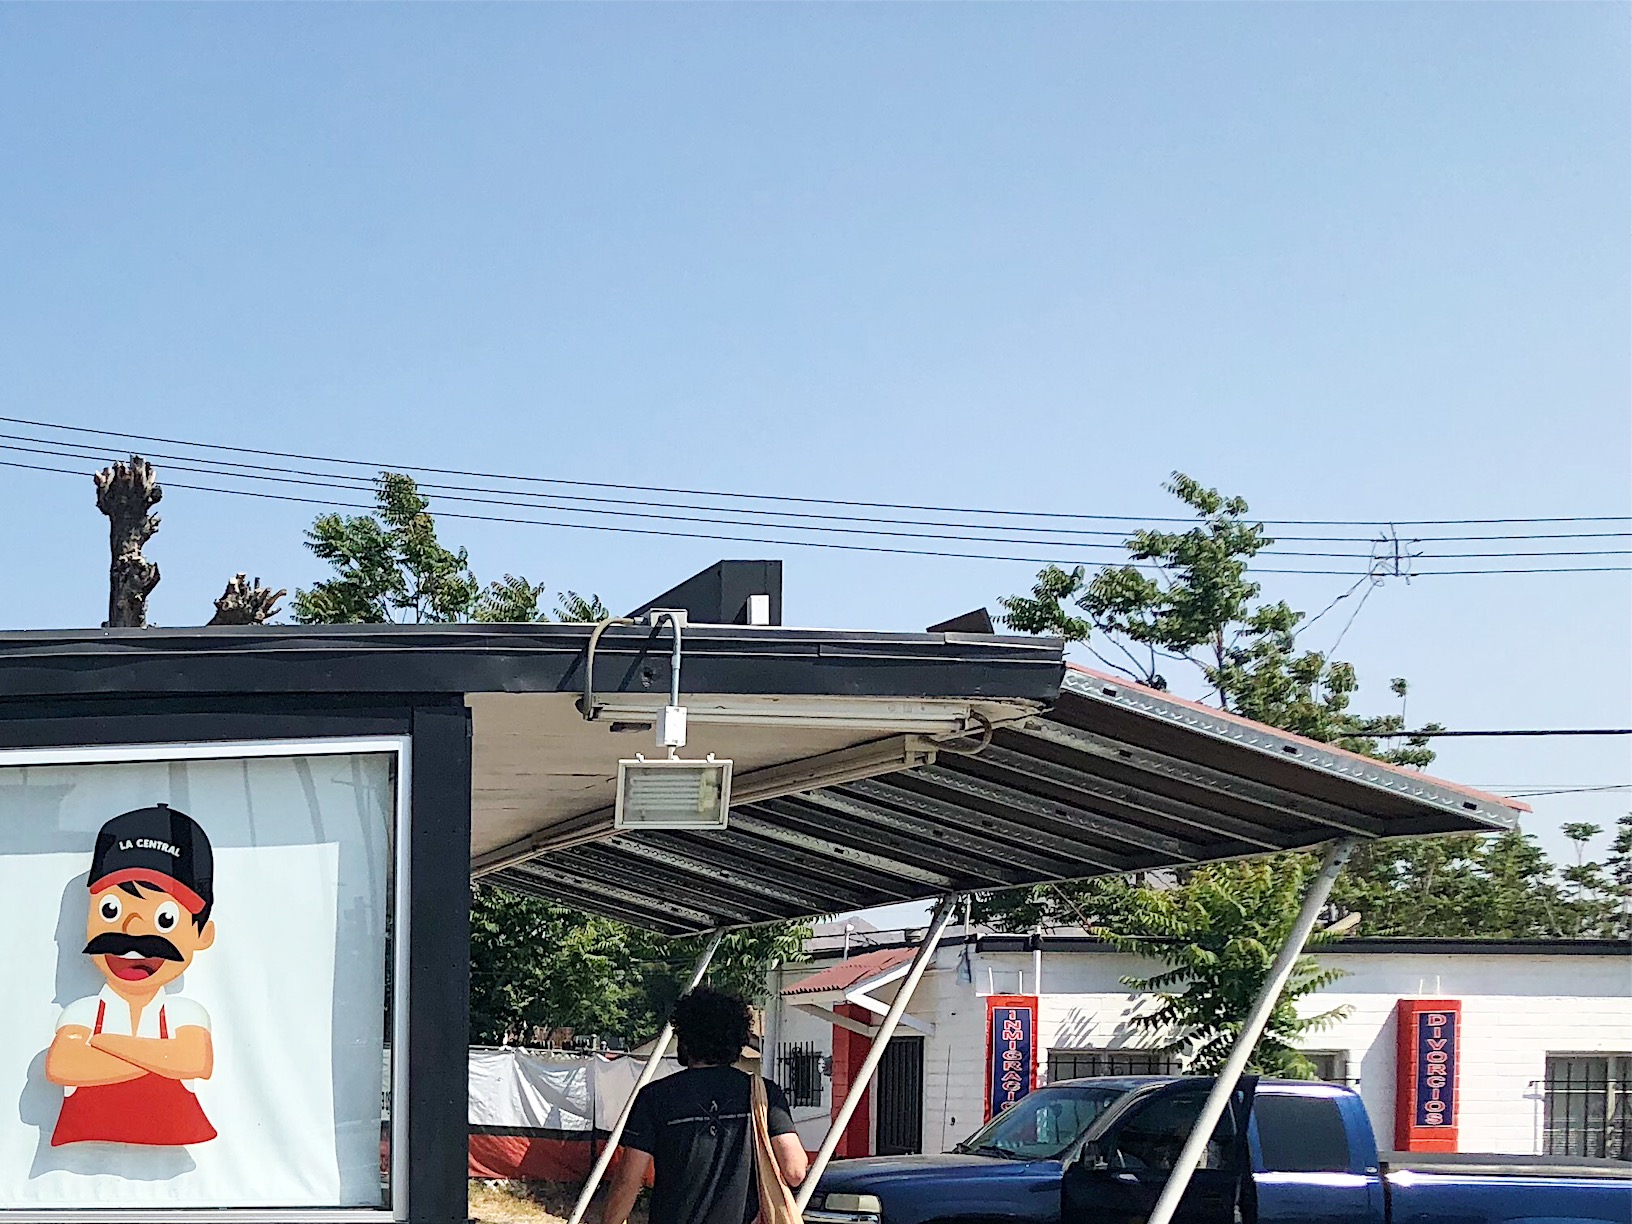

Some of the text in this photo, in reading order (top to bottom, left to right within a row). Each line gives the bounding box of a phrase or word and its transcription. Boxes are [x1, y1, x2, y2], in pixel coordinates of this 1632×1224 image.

[119, 839, 180, 857] LA CENTRAL
[1001, 1010, 1023, 1111] INMIGRACIO
[1425, 1014, 1448, 1125] DIVORCIOS
